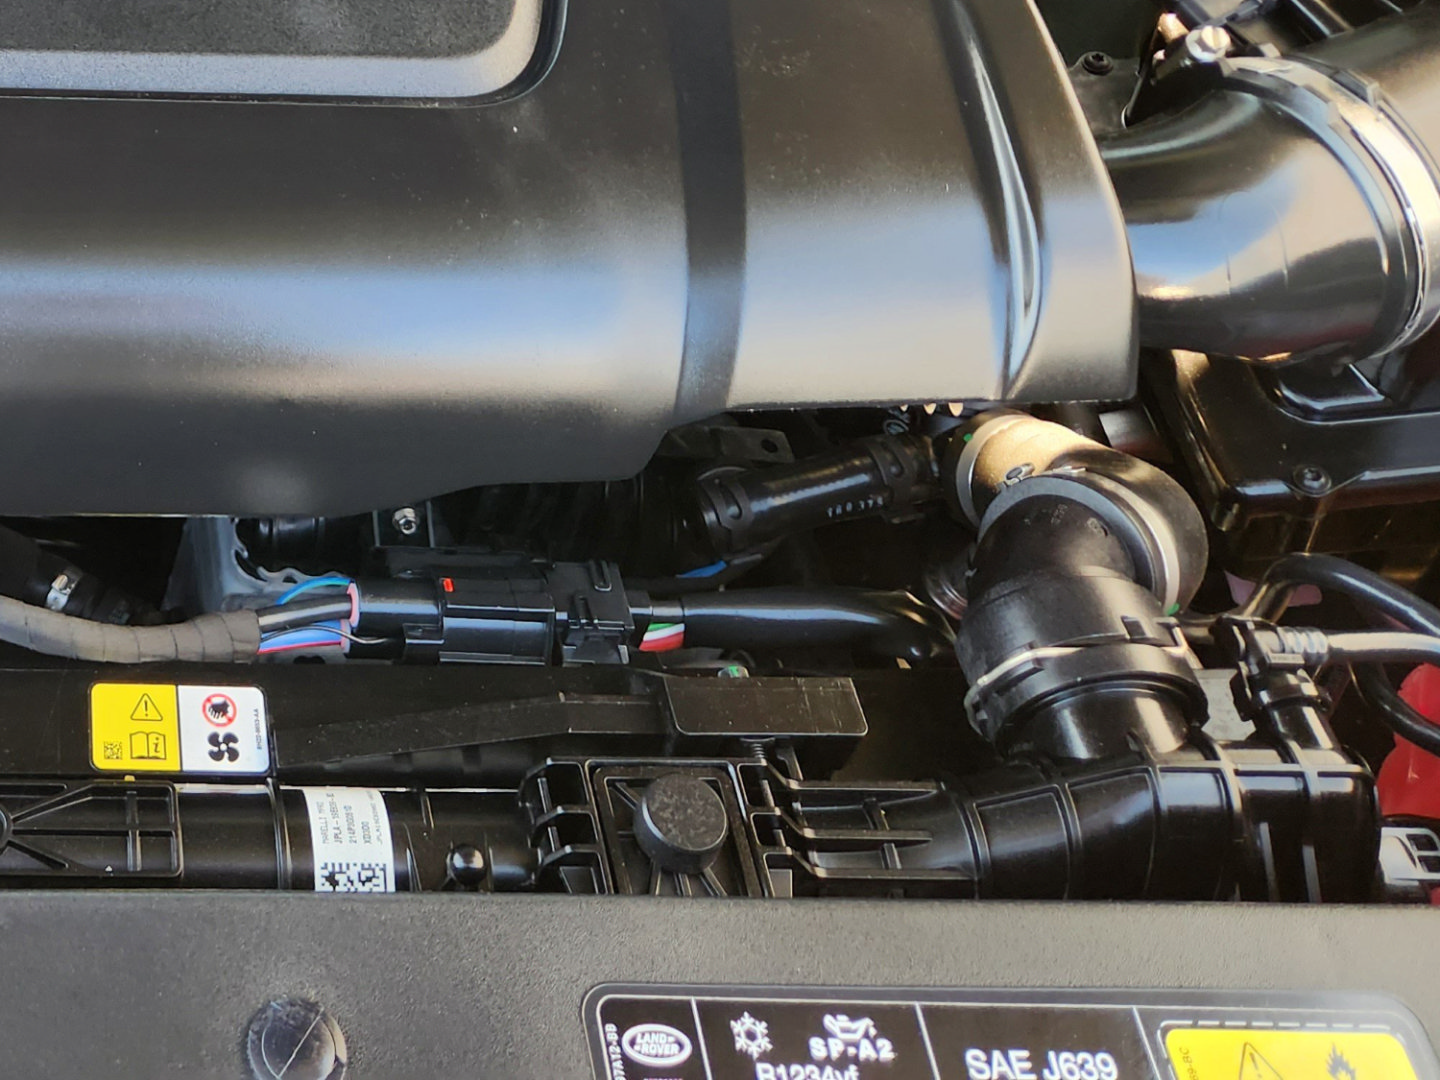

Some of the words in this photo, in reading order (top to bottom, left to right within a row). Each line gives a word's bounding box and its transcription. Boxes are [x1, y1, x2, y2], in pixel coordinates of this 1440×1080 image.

[636, 1031, 669, 1045] LAND
[640, 1043, 681, 1057] ROVER
[808, 1037, 896, 1062] SP-A2
[964, 1048, 1038, 1080] SAE
[1042, 1049, 1119, 1080] J639
